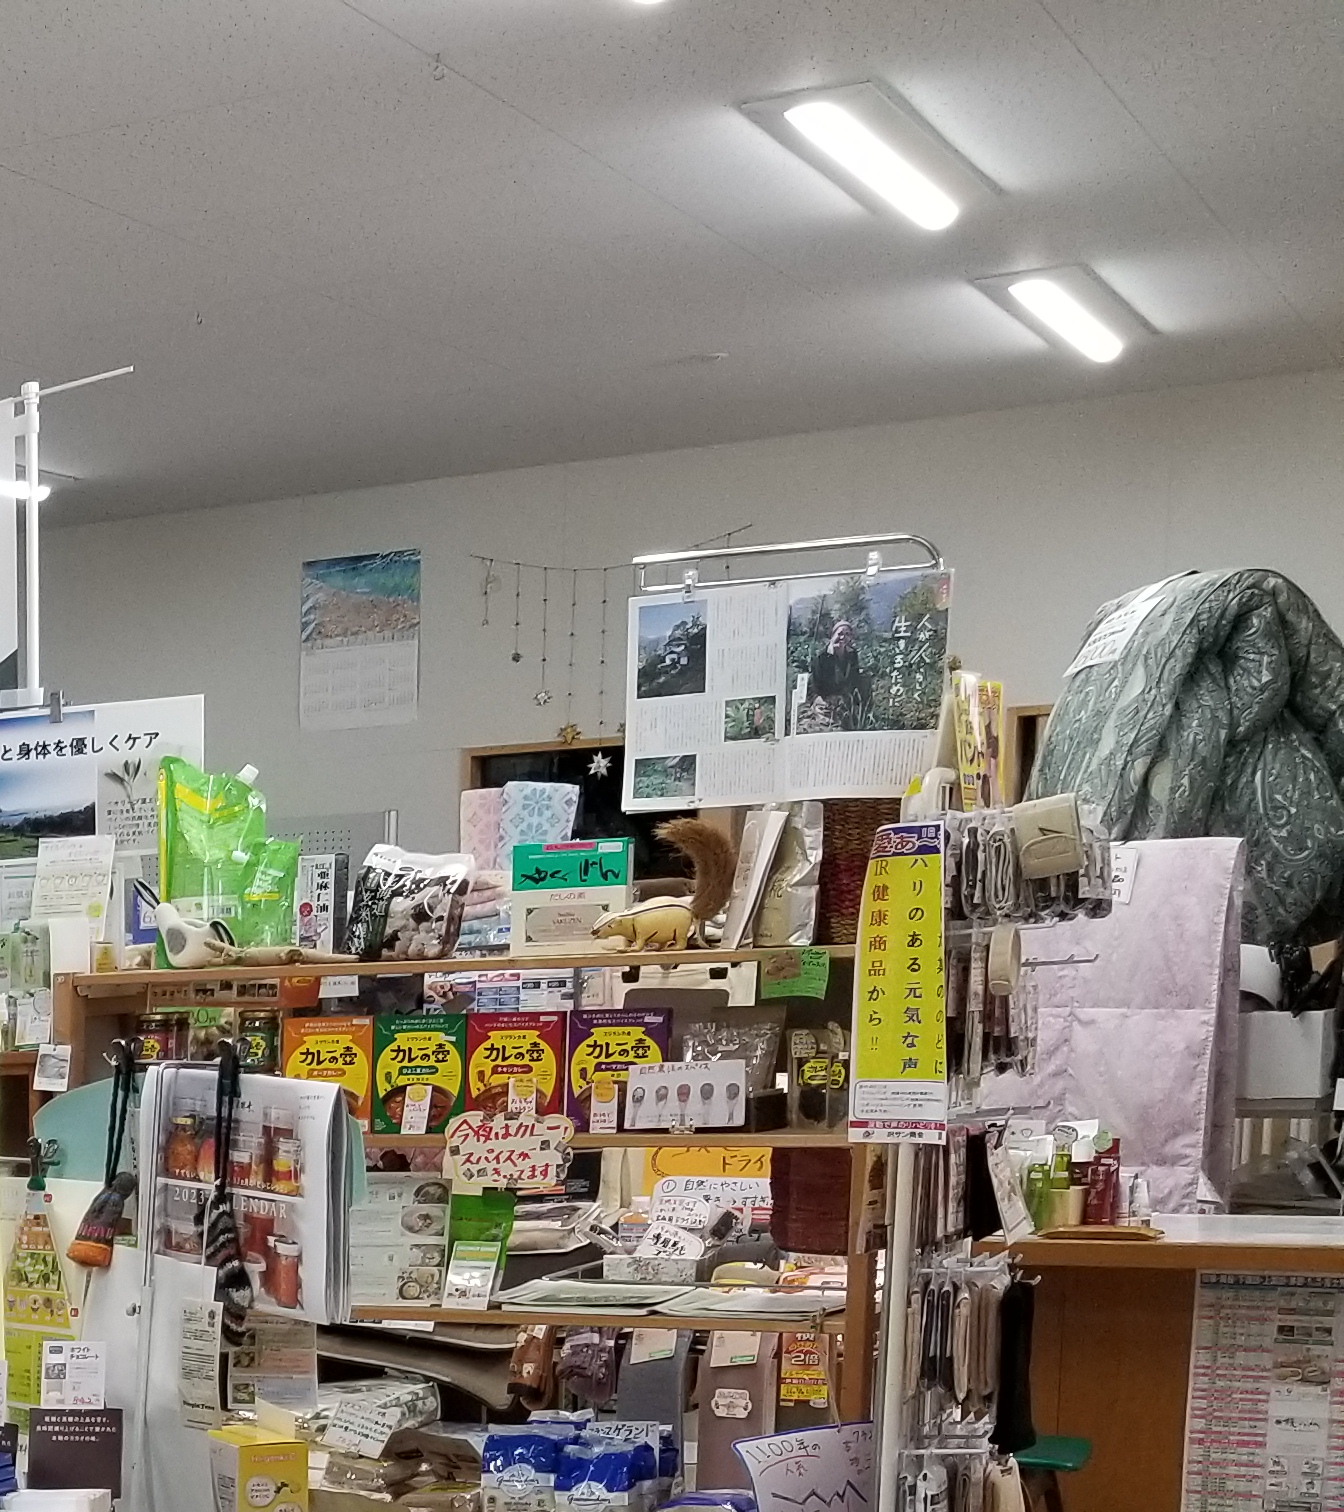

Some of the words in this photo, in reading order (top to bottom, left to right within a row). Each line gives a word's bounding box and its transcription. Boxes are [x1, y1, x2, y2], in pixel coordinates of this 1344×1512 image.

[900, 857, 929, 1076] ハリのある元気な声
[299, 1046, 358, 1067] カレーの壺
[389, 1042, 451, 1064] カレーの壺
[483, 1041, 546, 1063] カレーの壺
[585, 1037, 652, 1060] カレーの壺
[722, 1153, 766, 1174] ドライ
[173, 1187, 206, 1204] 2023
[683, 1179, 761, 1193] 自然にやさしい
